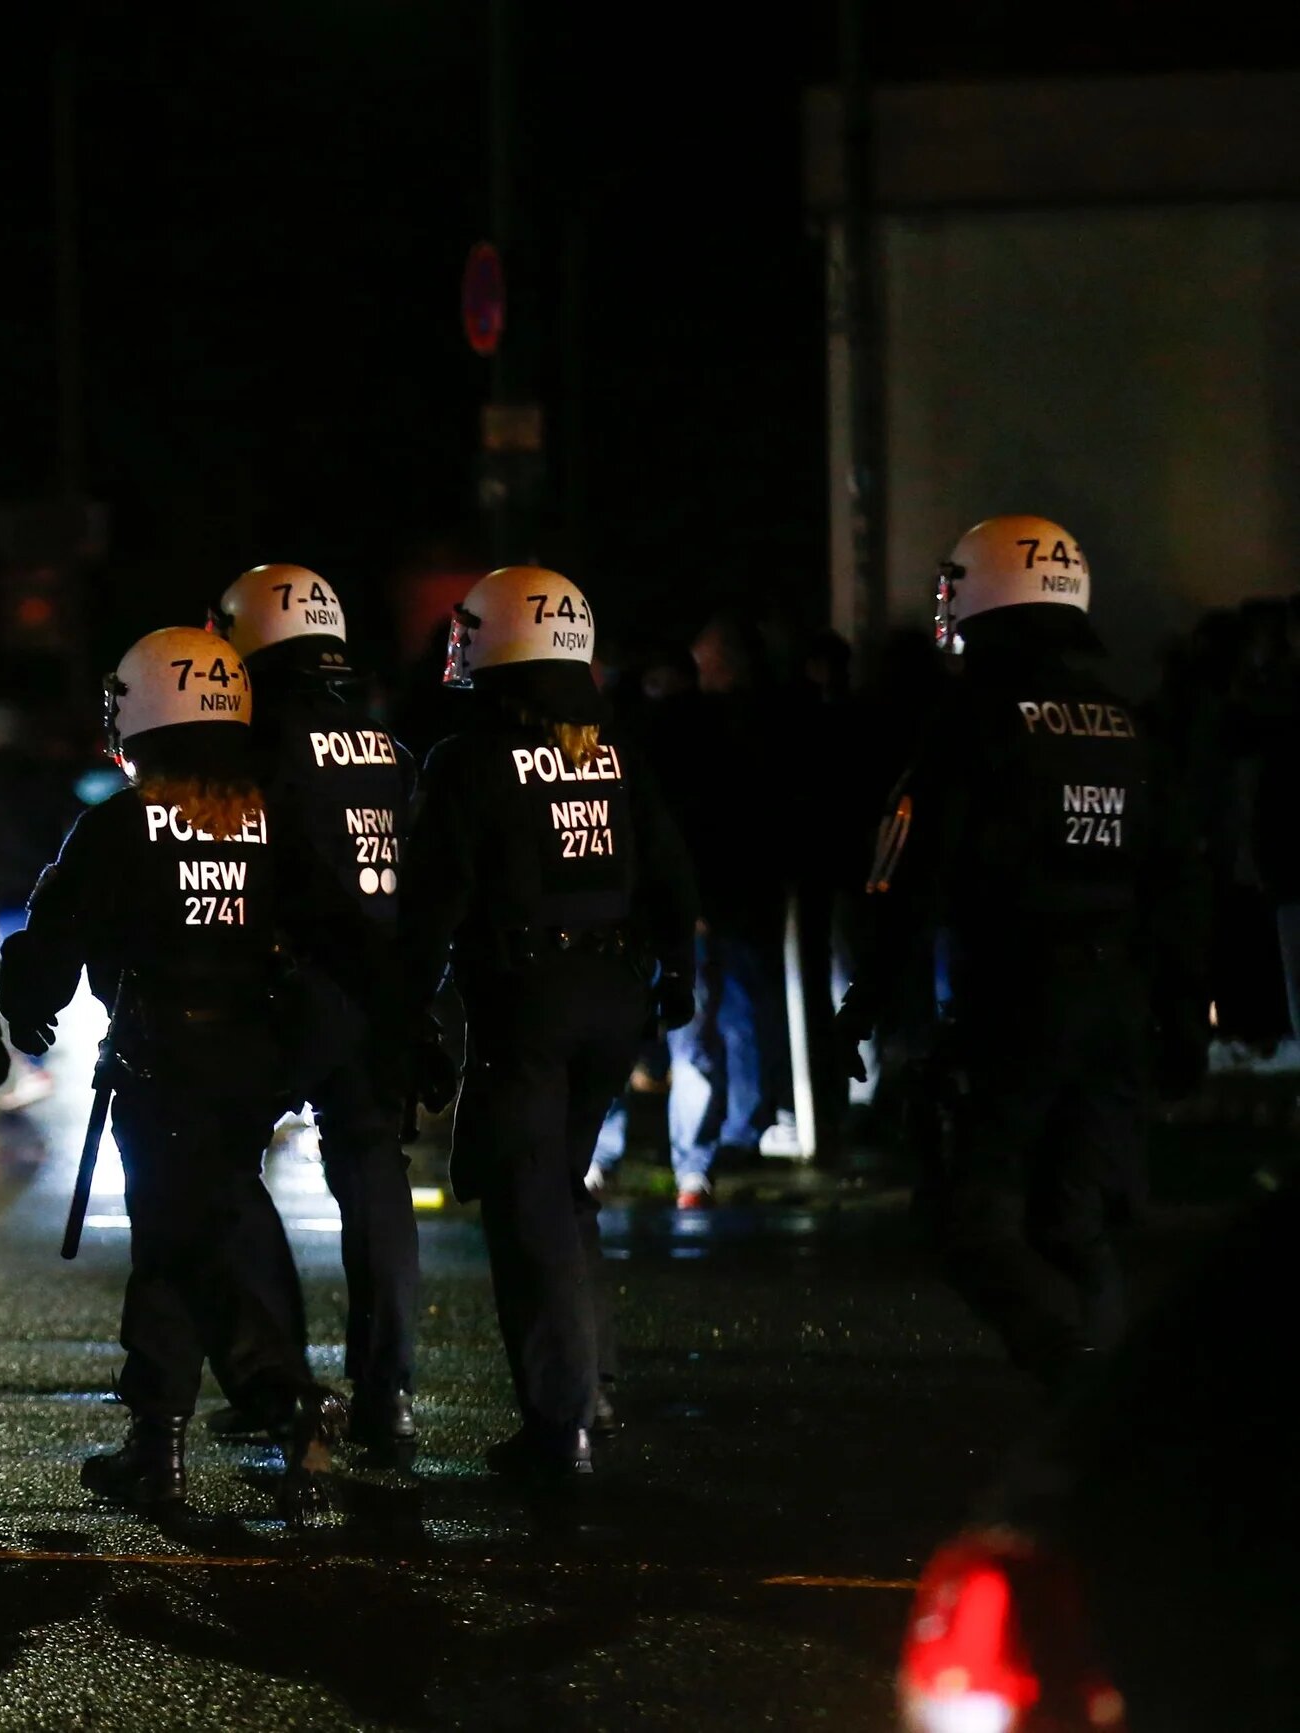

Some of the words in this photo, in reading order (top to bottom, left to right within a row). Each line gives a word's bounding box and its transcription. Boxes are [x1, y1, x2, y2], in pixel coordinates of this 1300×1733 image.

[1017, 701, 1138, 738] POLIZEI
[309, 730, 397, 767] POLIZEI
[551, 800, 608, 829] NRW
[1063, 784, 1126, 815] NRW
[346, 808, 393, 834] NRW
[1066, 816, 1123, 847] 2741
[355, 836, 399, 863] 2741
[561, 828, 613, 858] 2741
[179, 861, 247, 891] NRW
[185, 897, 245, 925] 2741
